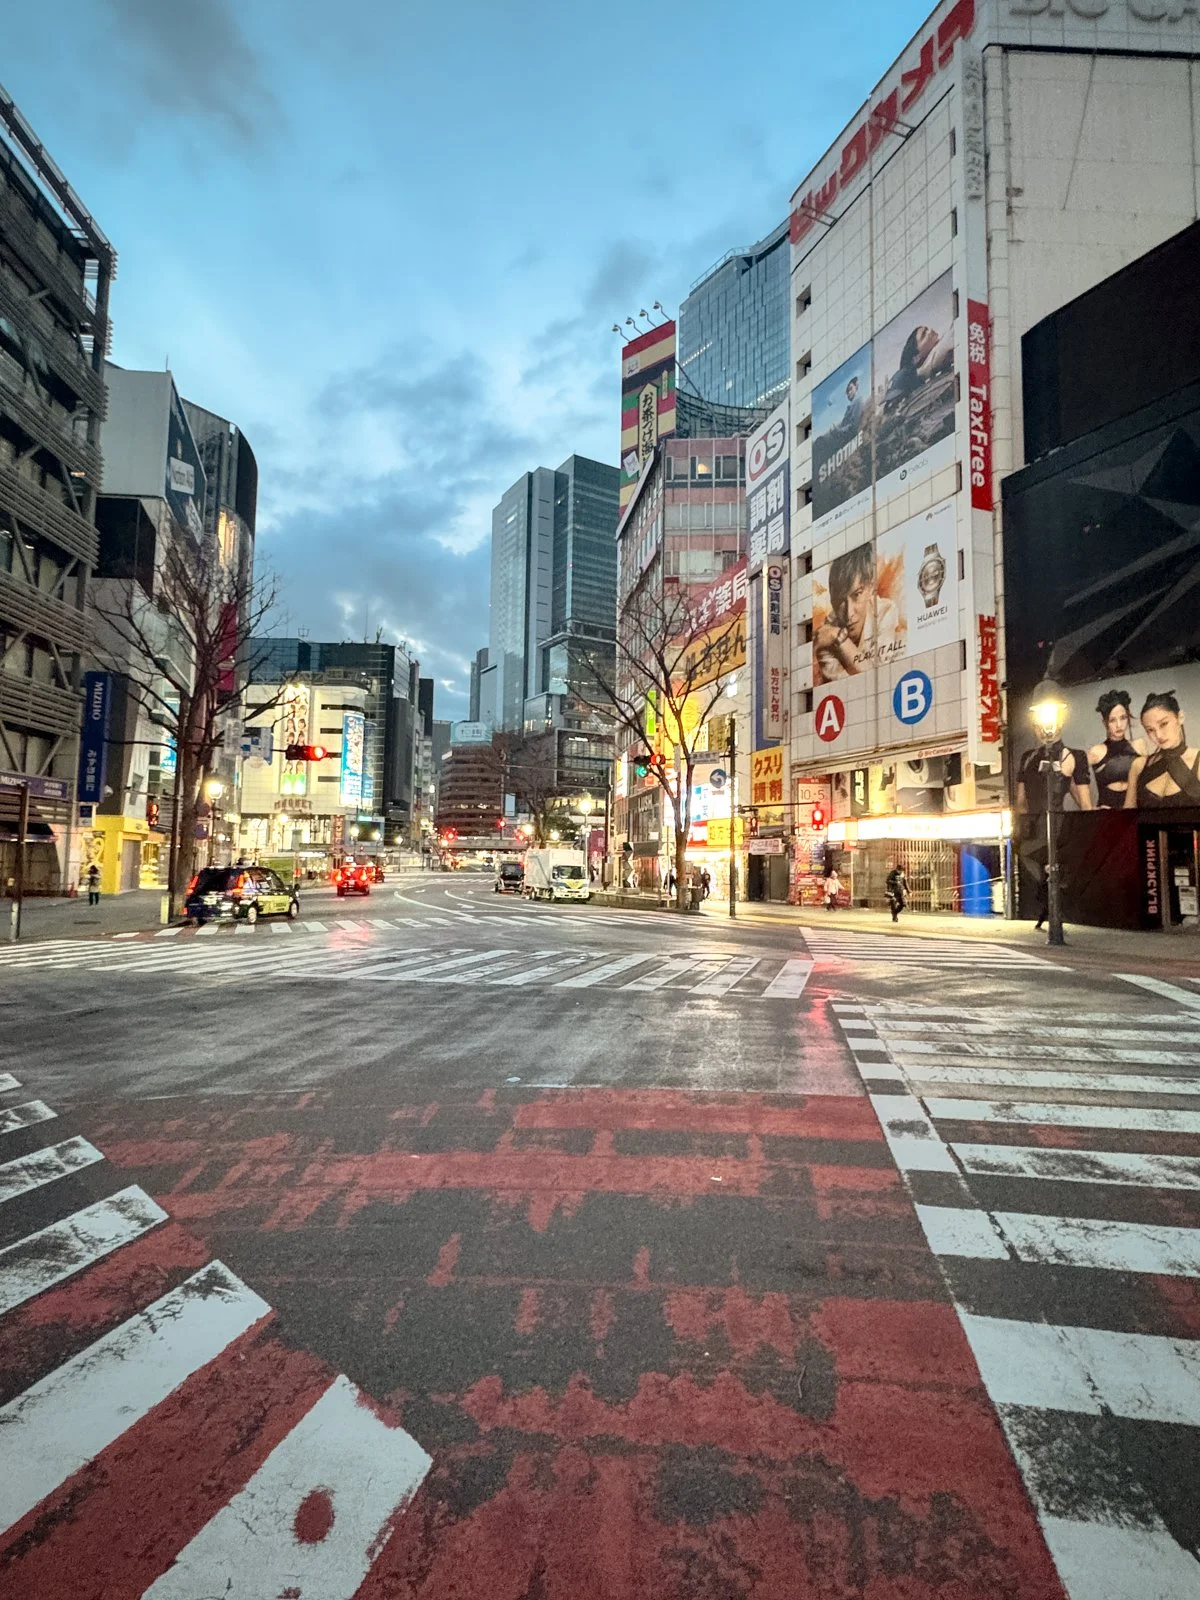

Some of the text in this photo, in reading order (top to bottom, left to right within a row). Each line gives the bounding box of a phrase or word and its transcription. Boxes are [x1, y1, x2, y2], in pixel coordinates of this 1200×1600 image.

[969, 322, 986, 366] 免税
[750, 421, 784, 475] OS
[970, 384, 988, 488] TaxFree
[750, 470, 785, 532] 調剤
[750, 511, 785, 570] 薬局
[917, 605, 948, 623] HUAWEI
[819, 700, 841, 736] A
[901, 677, 926, 719] B
[754, 753, 783, 779] クスリ
[854, 770, 865, 806] ASUS
